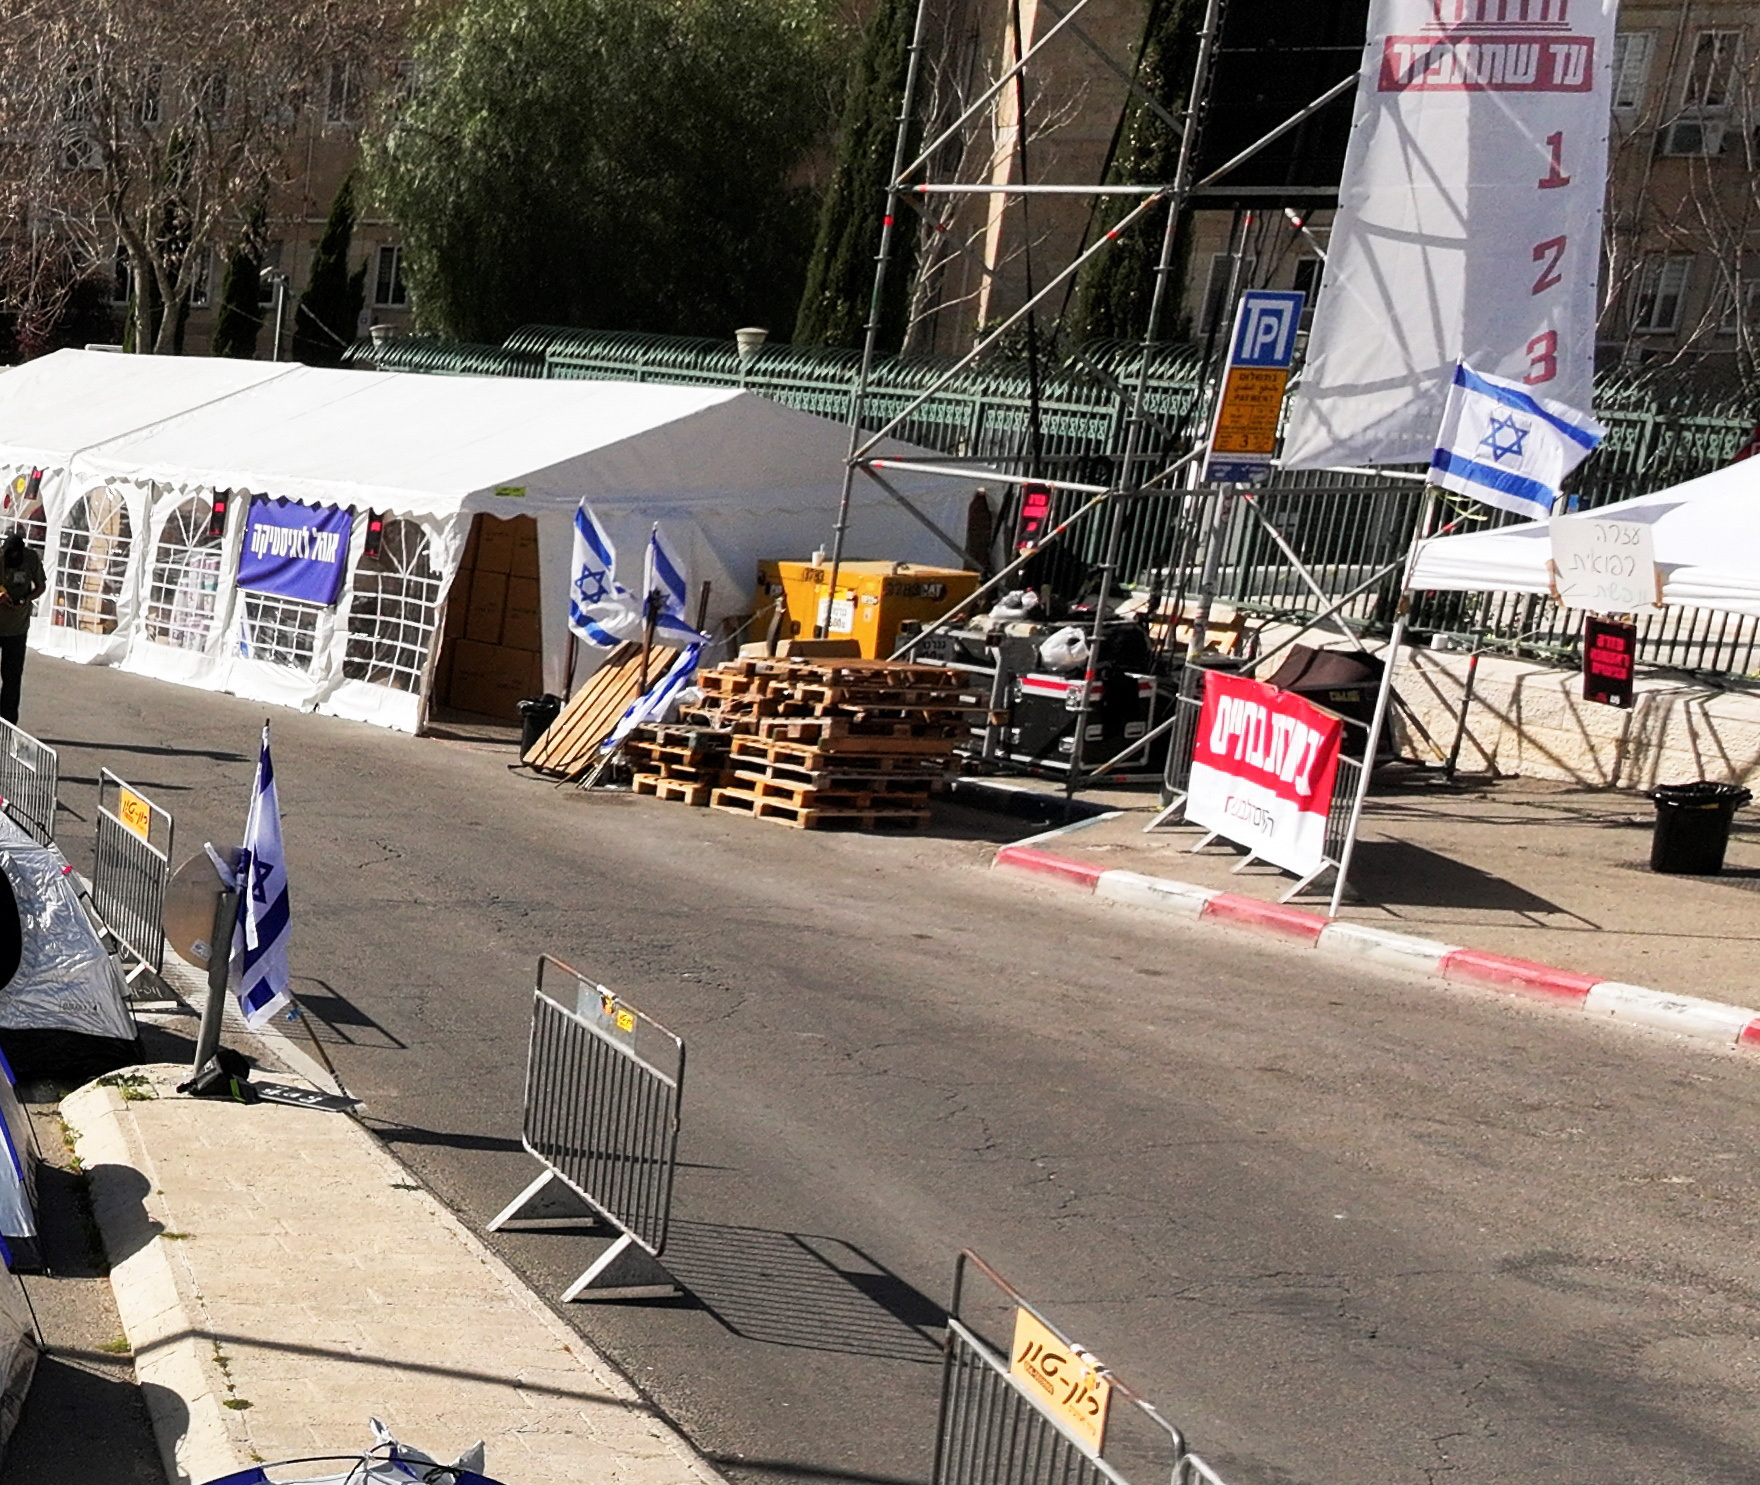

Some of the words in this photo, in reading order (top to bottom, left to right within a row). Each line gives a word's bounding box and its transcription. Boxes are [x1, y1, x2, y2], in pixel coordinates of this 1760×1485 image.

[1549, 44, 1588, 85] עד
[1537, 131, 1571, 189] 1
[1531, 235, 1567, 295] 2
[1253, 316, 1279, 359] P
[1523, 330, 1558, 385] 3
[251, 523, 309, 560] לוגיסטיקה
[311, 527, 340, 563] אוהל
[1594, 524, 1642, 547] עזרה
